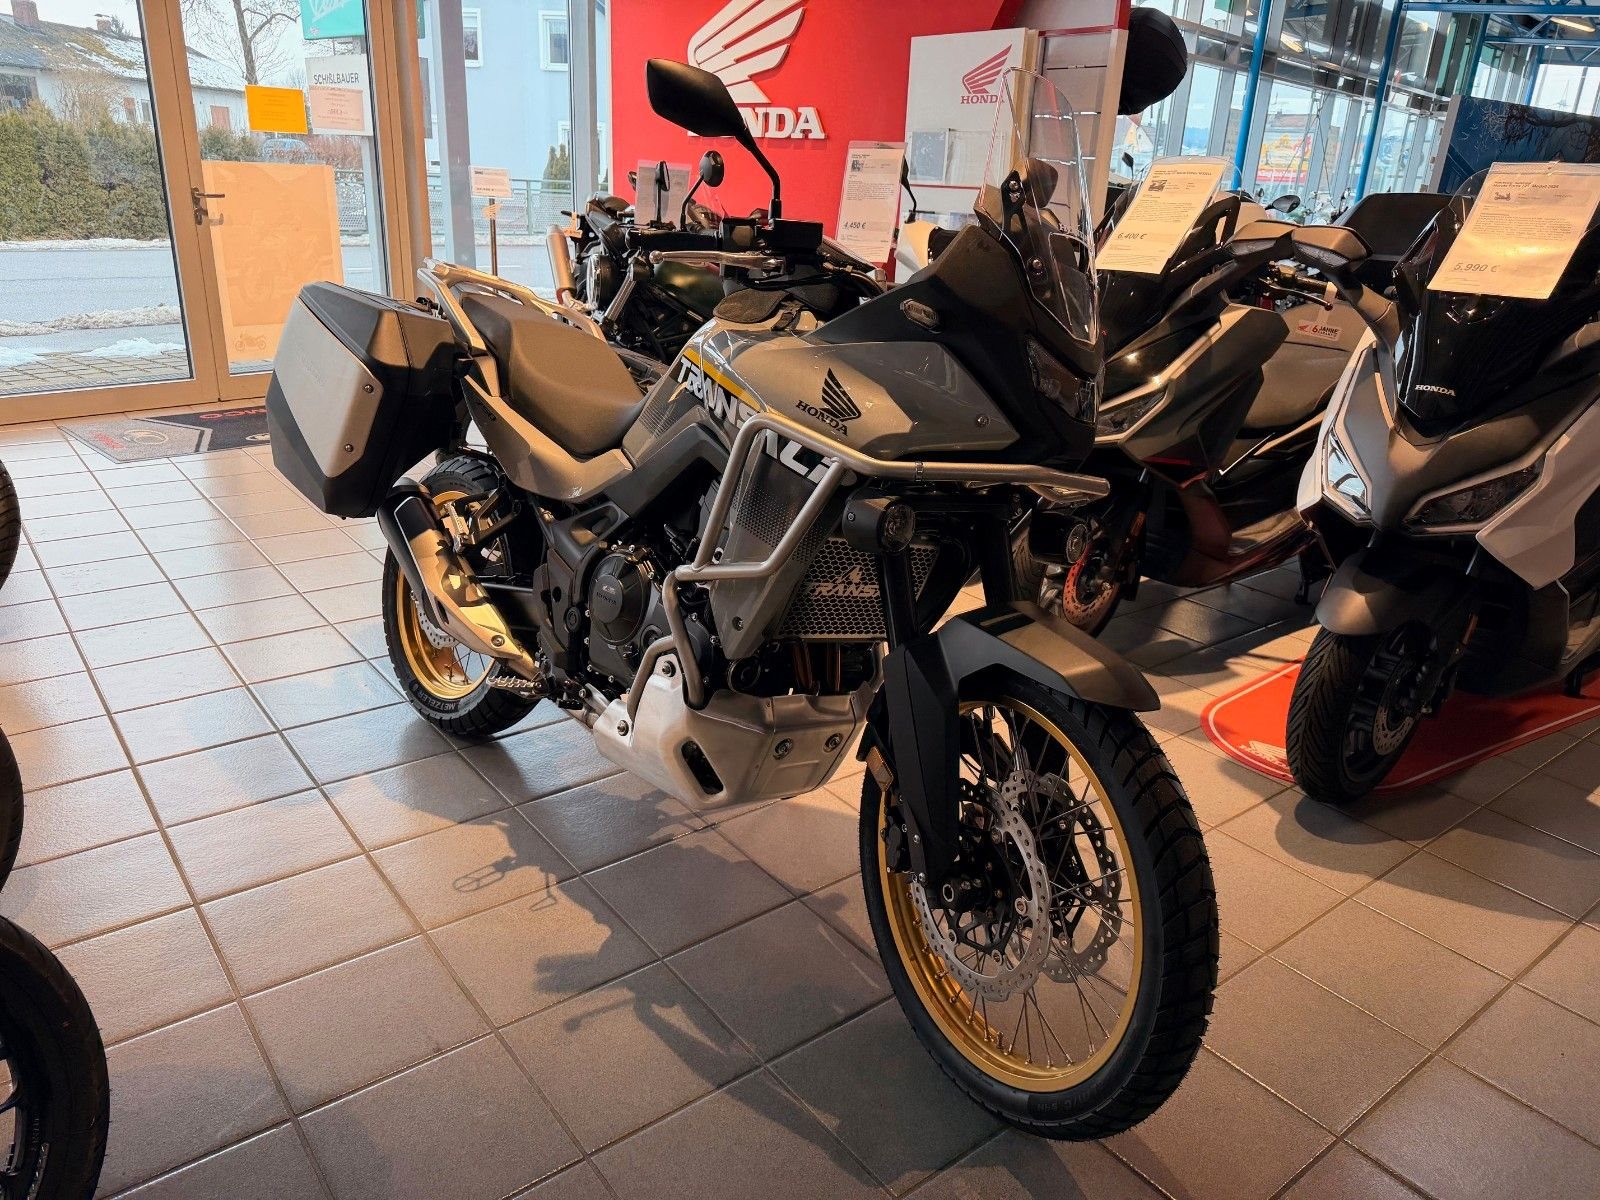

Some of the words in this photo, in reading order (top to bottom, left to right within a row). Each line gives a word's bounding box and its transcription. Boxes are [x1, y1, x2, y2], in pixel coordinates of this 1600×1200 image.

[687, 106, 827, 139] NDA
[1453, 262, 1488, 273] 5.990
[1415, 384, 1456, 397] HONDA
[795, 399, 848, 437] HONDA
[802, 581, 881, 599] TRANS
